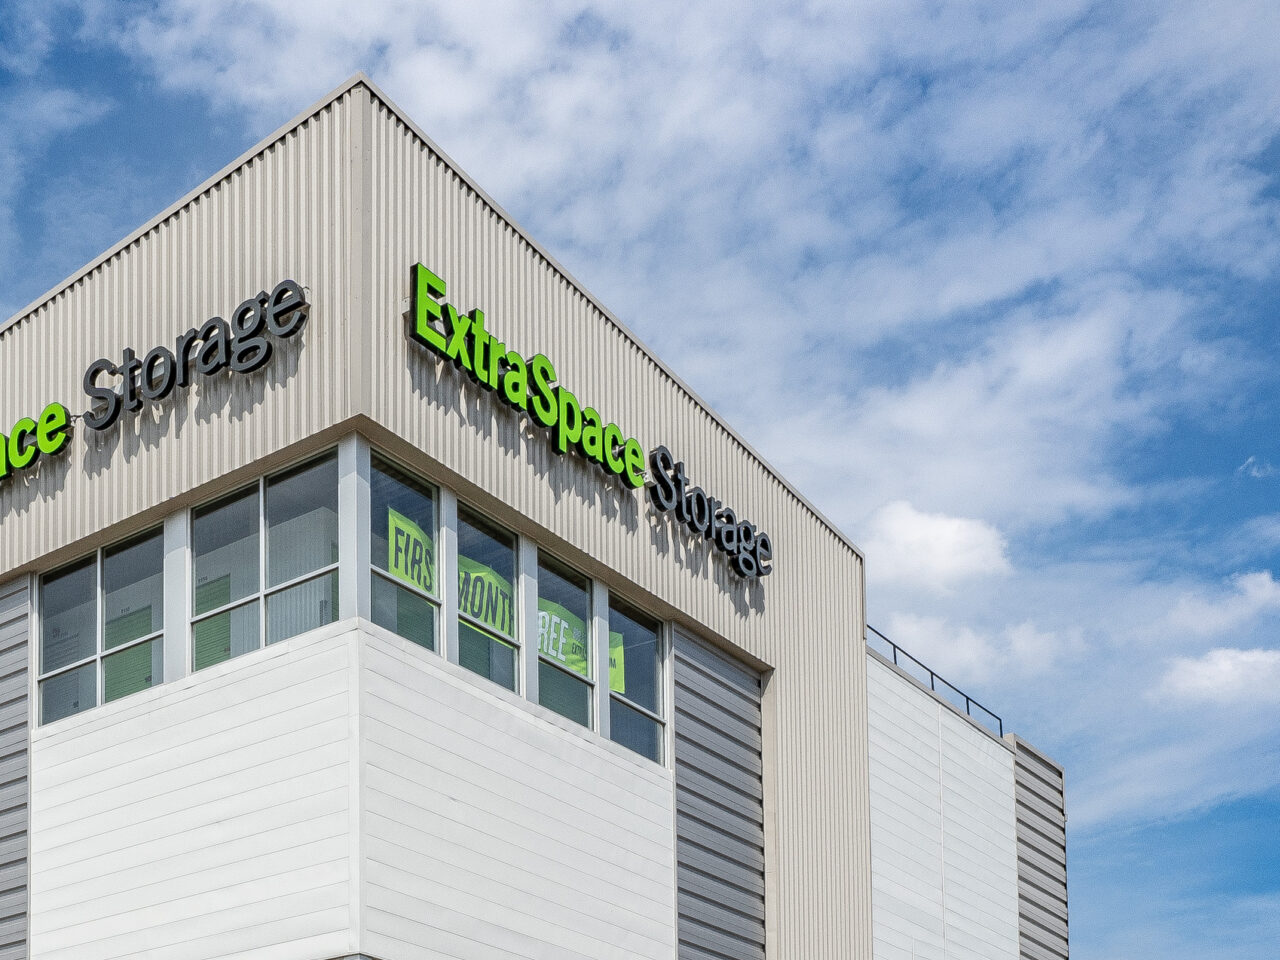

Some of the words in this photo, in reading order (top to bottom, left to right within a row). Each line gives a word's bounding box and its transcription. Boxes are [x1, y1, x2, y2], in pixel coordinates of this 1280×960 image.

[83, 279, 309, 431] Storage
[650, 445, 773, 578] Storage
[394, 526, 432, 592] FIRS
[538, 610, 569, 661] REE
